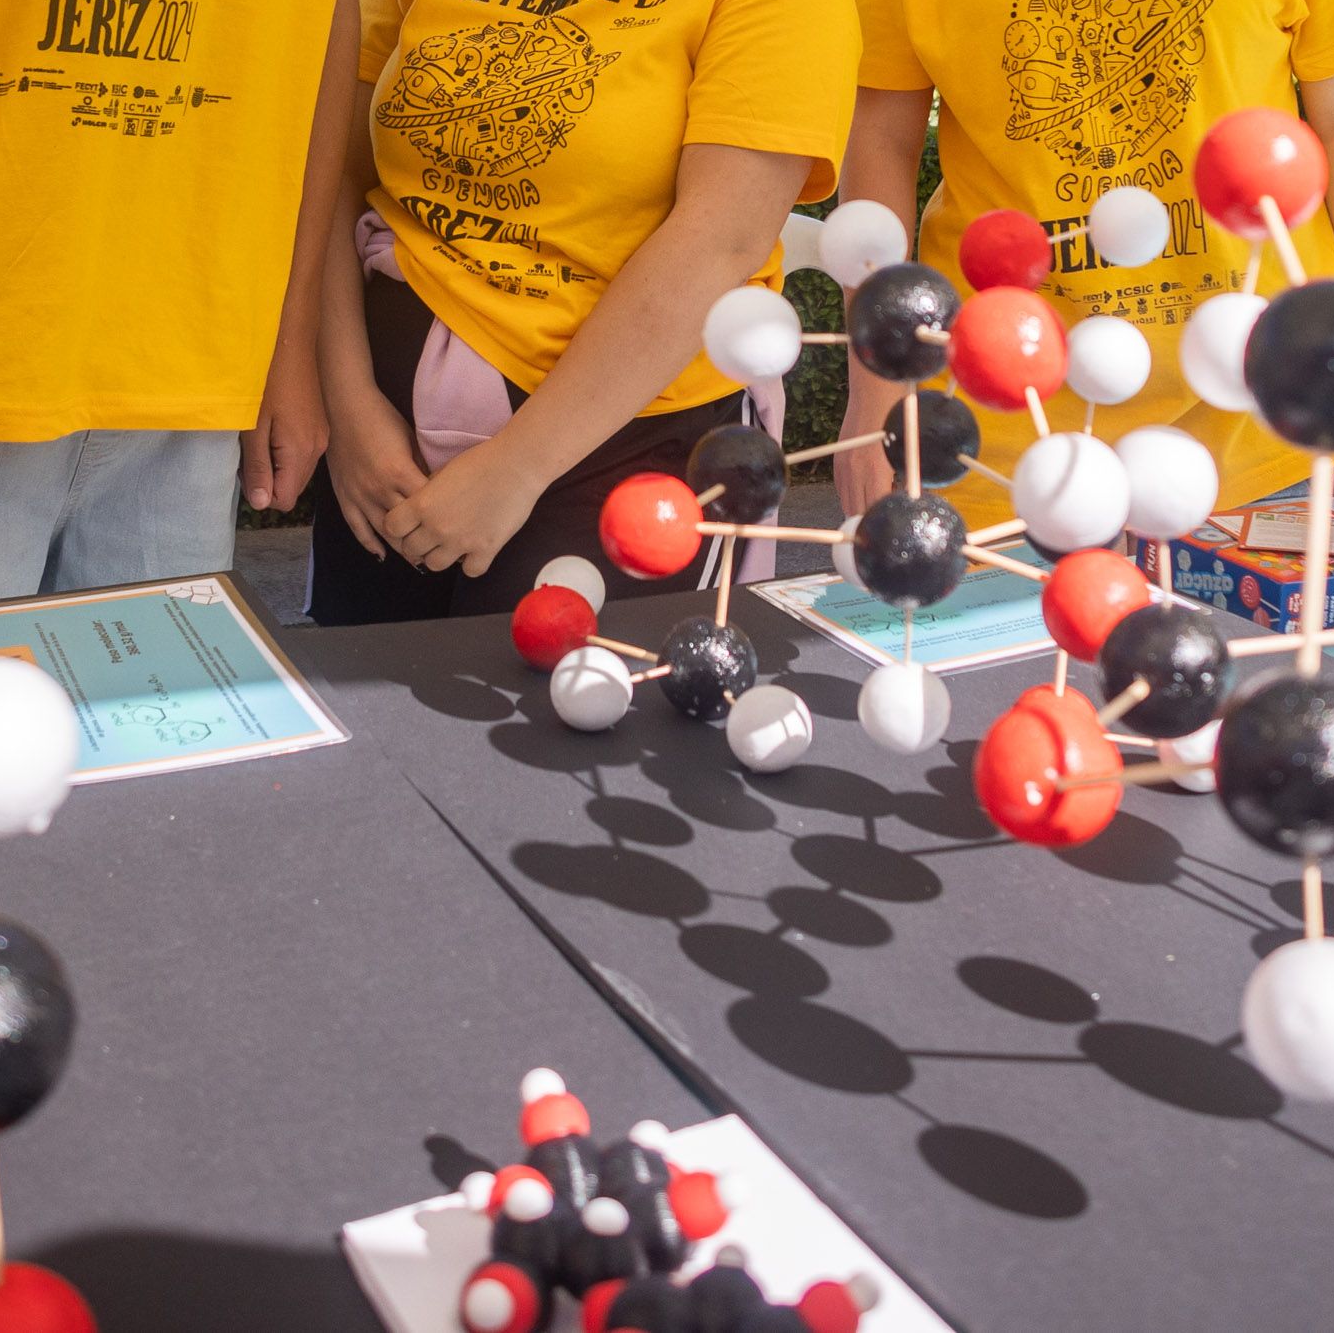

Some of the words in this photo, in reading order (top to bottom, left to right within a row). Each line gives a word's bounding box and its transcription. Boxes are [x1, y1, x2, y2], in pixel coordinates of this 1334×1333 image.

[143, 0, 198, 63] 2024
[422, 168, 541, 211] CIENCIA
[1123, 284, 1155, 297] CSIC
